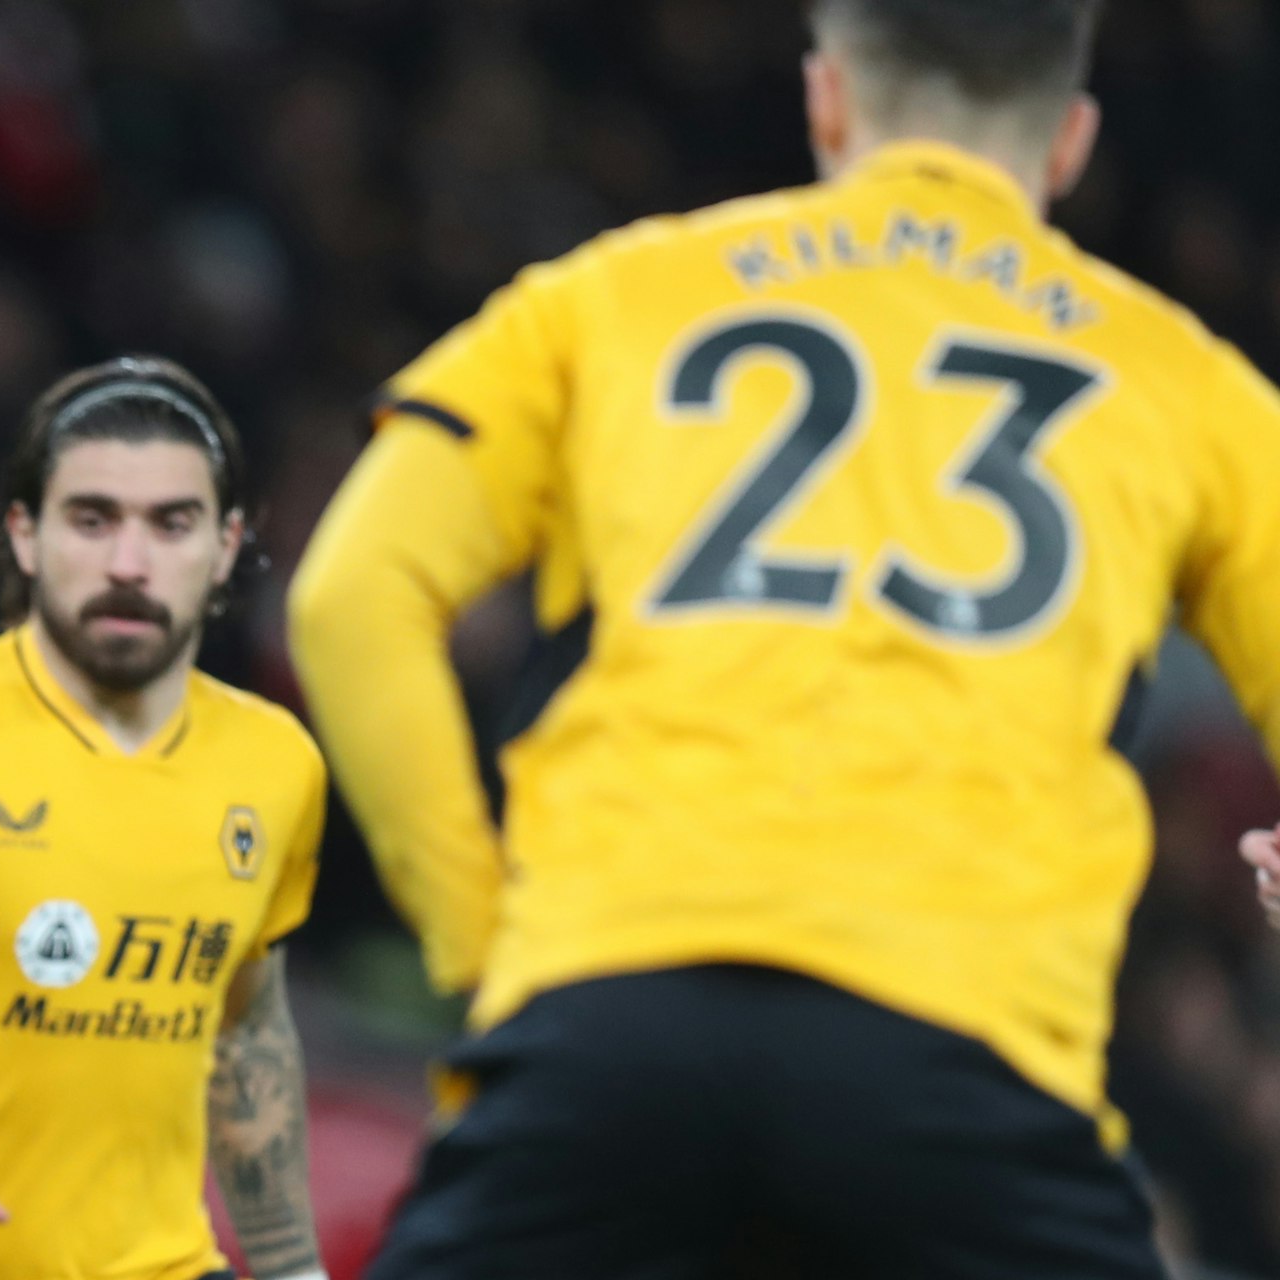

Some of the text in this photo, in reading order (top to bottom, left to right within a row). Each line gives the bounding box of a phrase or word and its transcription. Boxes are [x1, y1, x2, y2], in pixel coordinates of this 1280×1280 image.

[730, 210, 1102, 330] KILMAN
[643, 312, 1108, 642] 23
[103, 914, 234, 987] 万博
[2, 993, 209, 1042] ManBetX
